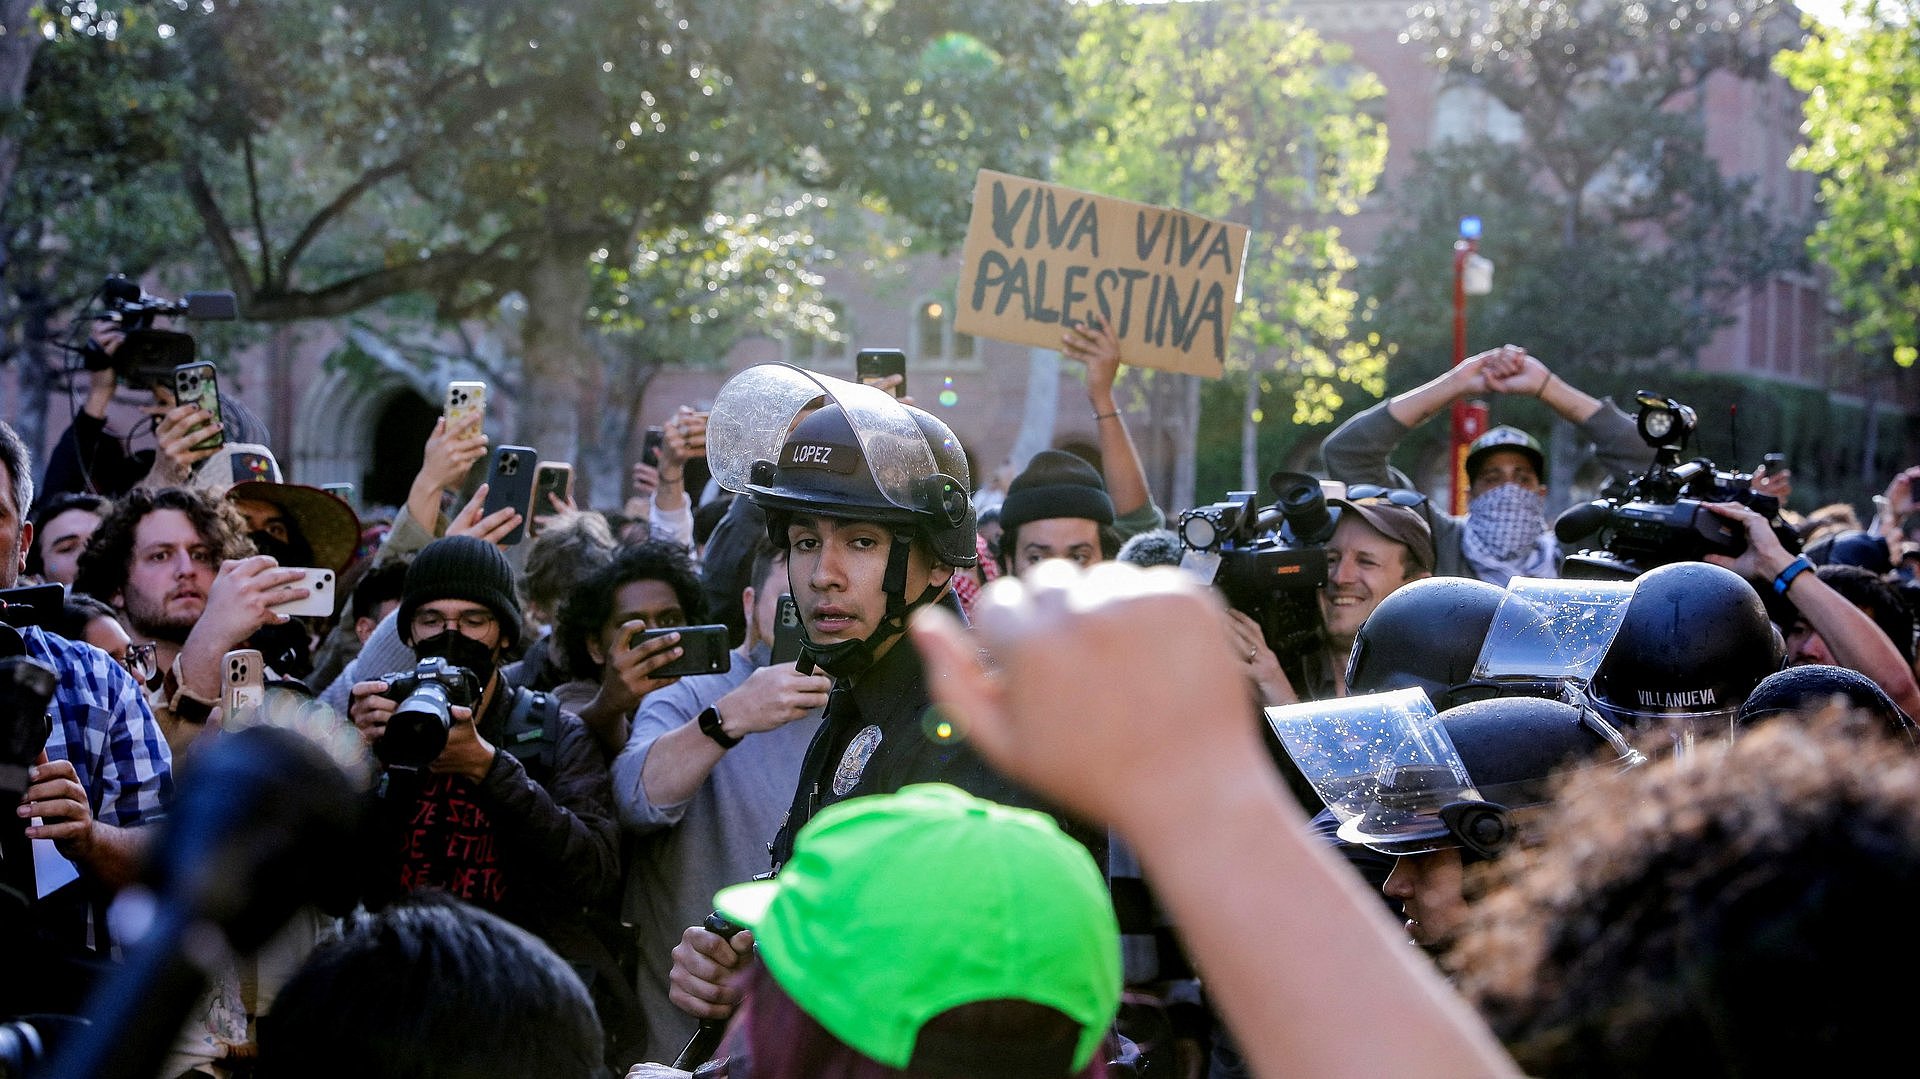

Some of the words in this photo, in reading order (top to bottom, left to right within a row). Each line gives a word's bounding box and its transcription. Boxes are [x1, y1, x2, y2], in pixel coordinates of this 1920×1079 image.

[991, 180, 1099, 258] VIVA
[1136, 211, 1232, 274] VIVA
[971, 249, 1225, 363] PALESTINA
[792, 445, 832, 464] LOPEZ
[1637, 688, 1717, 708] VILLANUEVA
